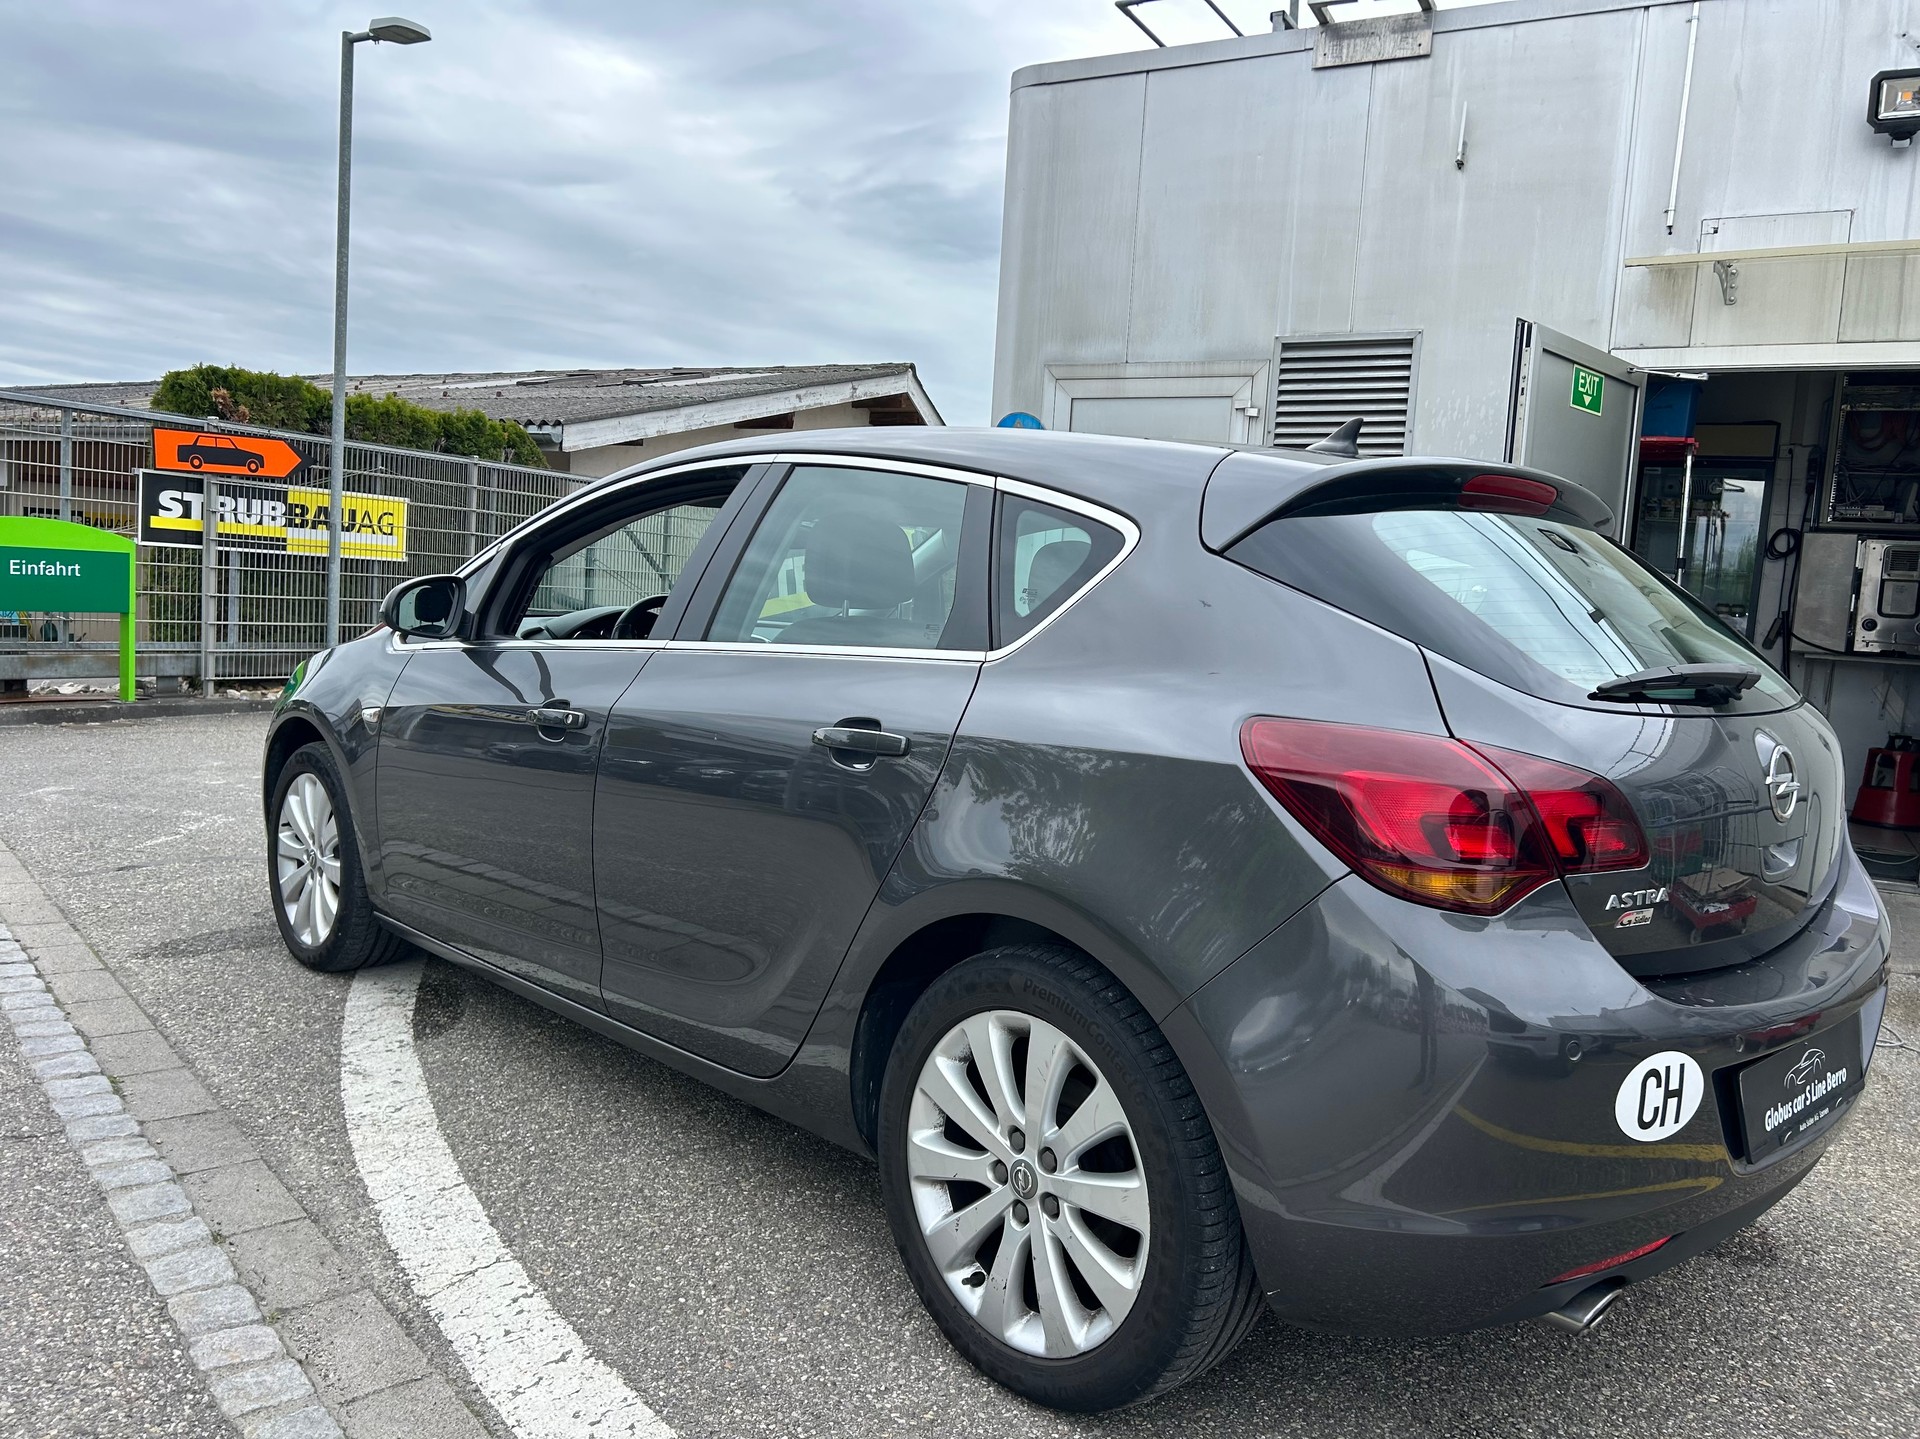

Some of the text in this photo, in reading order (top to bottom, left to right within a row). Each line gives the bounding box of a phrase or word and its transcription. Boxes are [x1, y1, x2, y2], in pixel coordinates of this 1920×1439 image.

[1578, 371, 1600, 397] EXIT
[9, 559, 81, 577] Einfahrt
[1605, 888, 1669, 910] ASTRA
[1637, 1062, 1686, 1131] CH
[1764, 1068, 1847, 1132] Globus car S Line Berro
